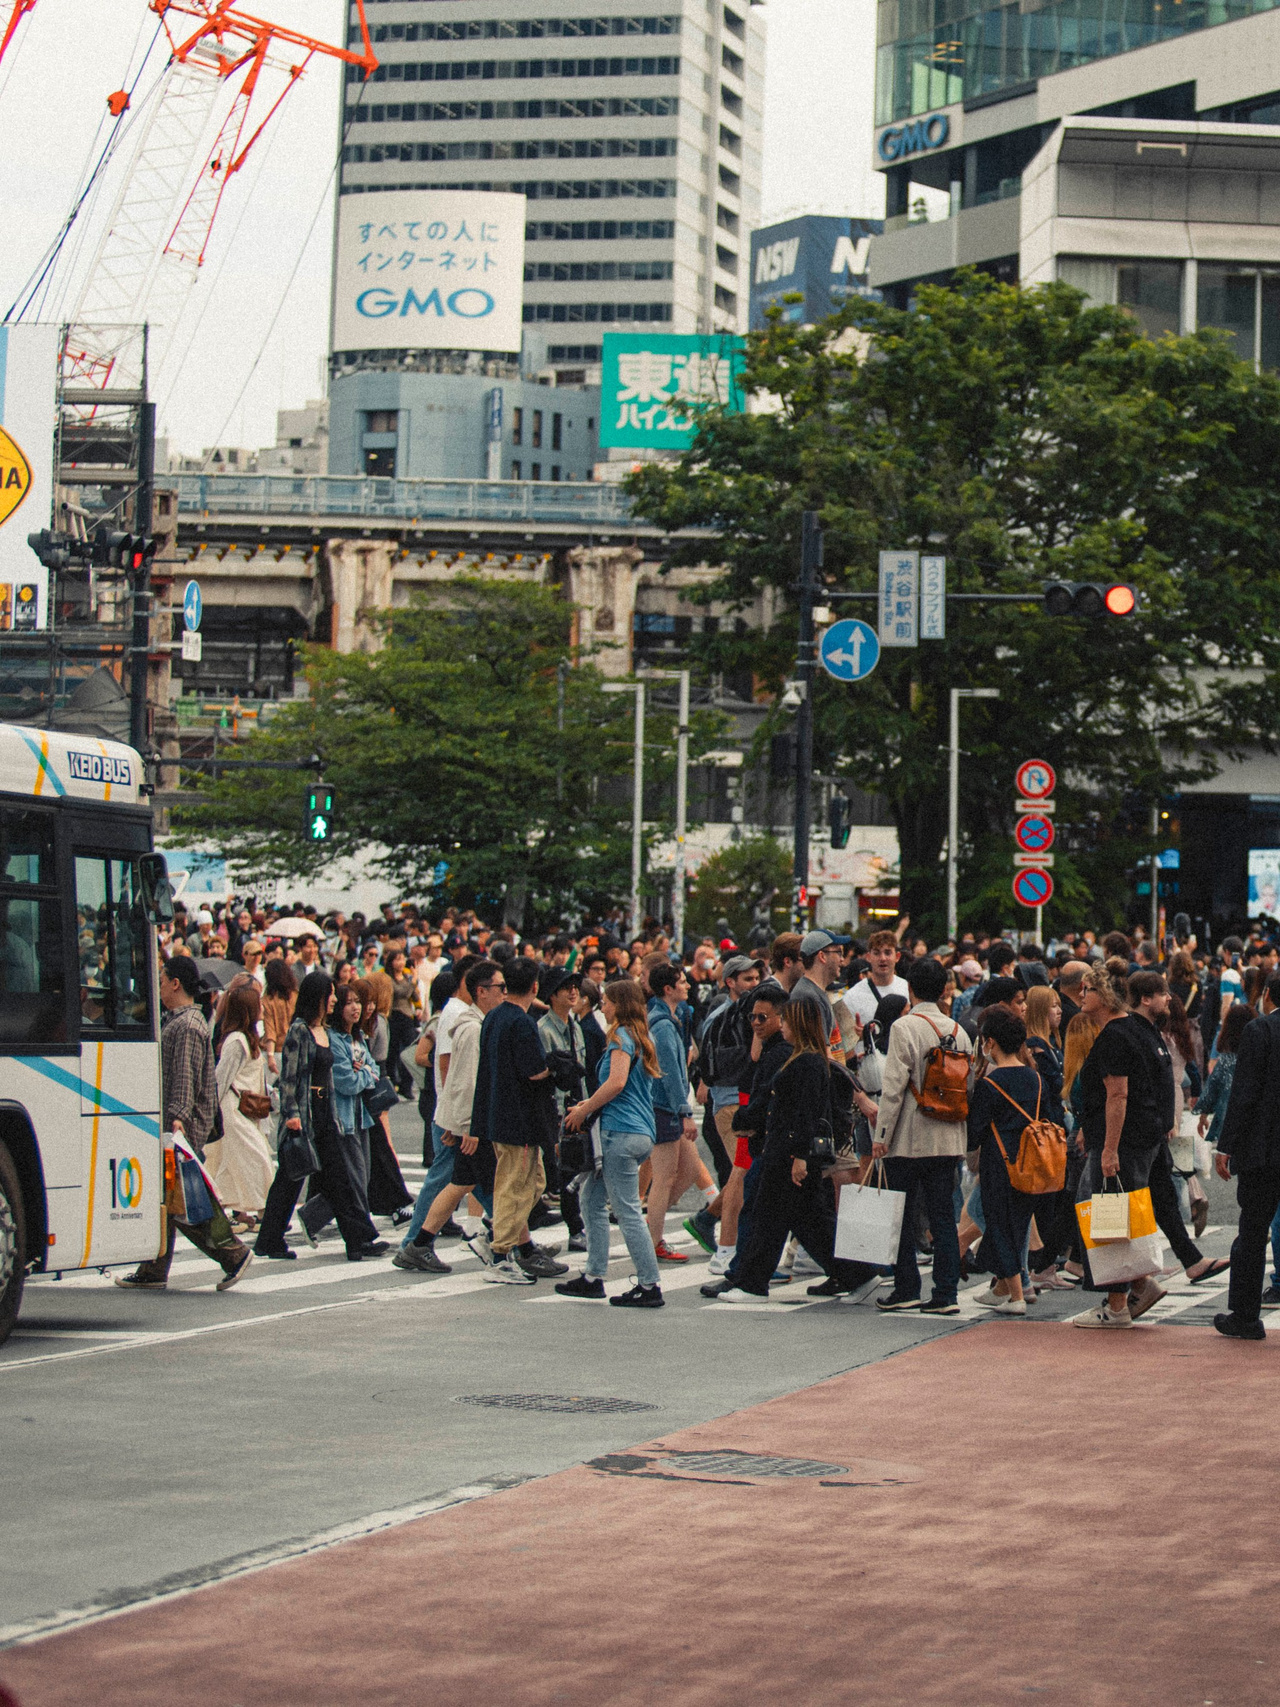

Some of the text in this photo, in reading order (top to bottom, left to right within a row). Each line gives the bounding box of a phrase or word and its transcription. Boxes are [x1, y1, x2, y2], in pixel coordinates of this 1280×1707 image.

[878, 114, 949, 162] GMO
[358, 221, 499, 244] すべての人に
[830, 233, 876, 274] N
[357, 251, 498, 272] インターネット
[755, 237, 800, 284] NSW
[356, 288, 494, 318] GMO
[617, 352, 730, 404] 東進
[896, 560, 912, 638] 渋谷駅前
[70, 753, 130, 784] KEIO BUS
[109, 1157, 143, 1209] 100
